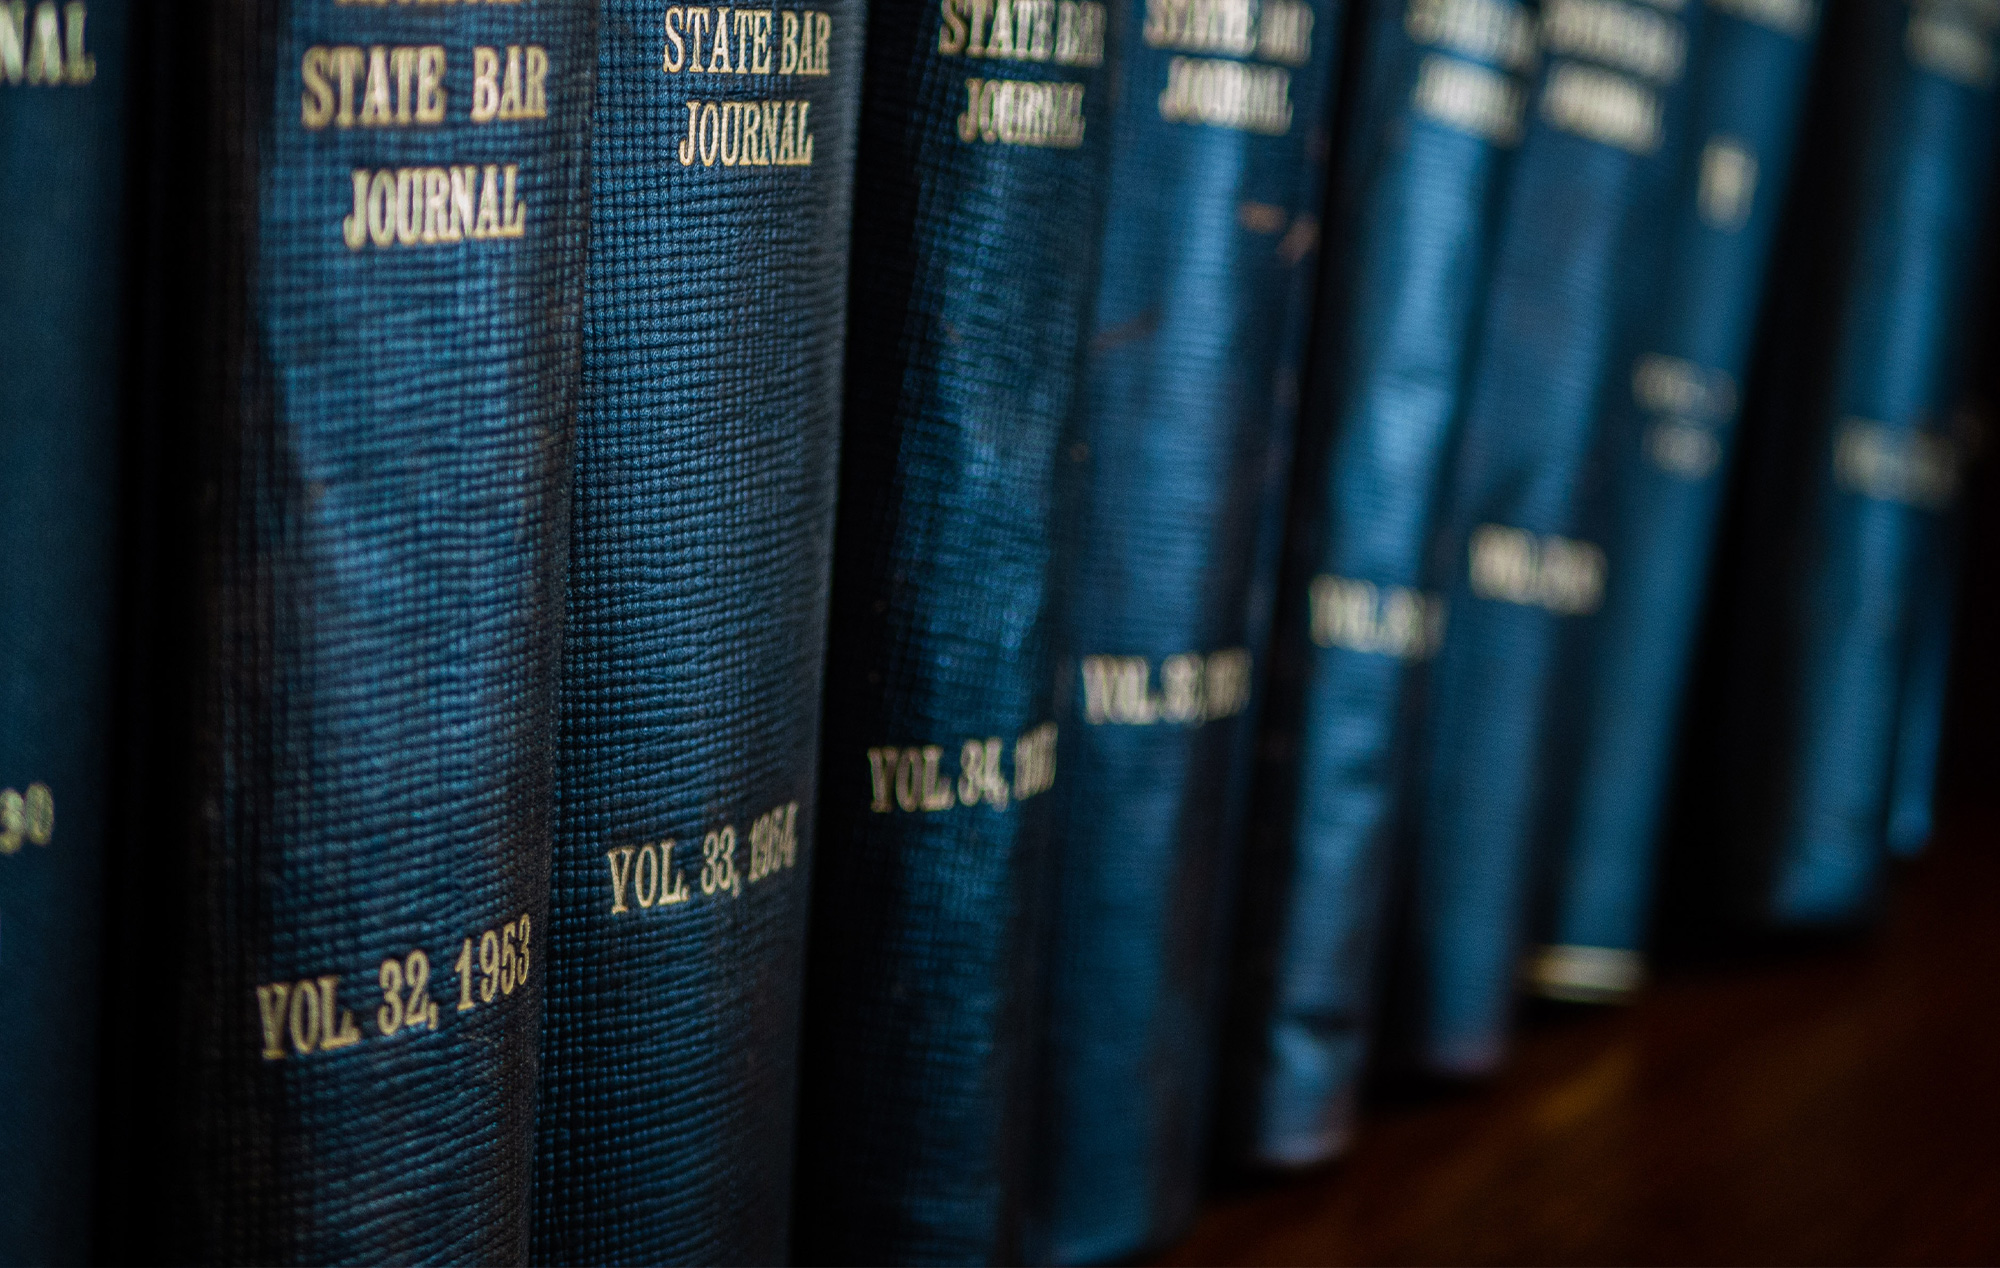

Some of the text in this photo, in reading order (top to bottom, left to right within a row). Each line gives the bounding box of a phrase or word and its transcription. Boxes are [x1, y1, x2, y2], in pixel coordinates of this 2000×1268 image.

[665, 6, 832, 76] STATE BAR
[301, 44, 549, 128] STATE BAR
[678, 100, 814, 167] JOURNAL
[343, 164, 526, 250] JOURNAL
[701, 825, 741, 899] 33,
[377, 949, 439, 1036] 32,
[454, 913, 532, 1011] 1953
